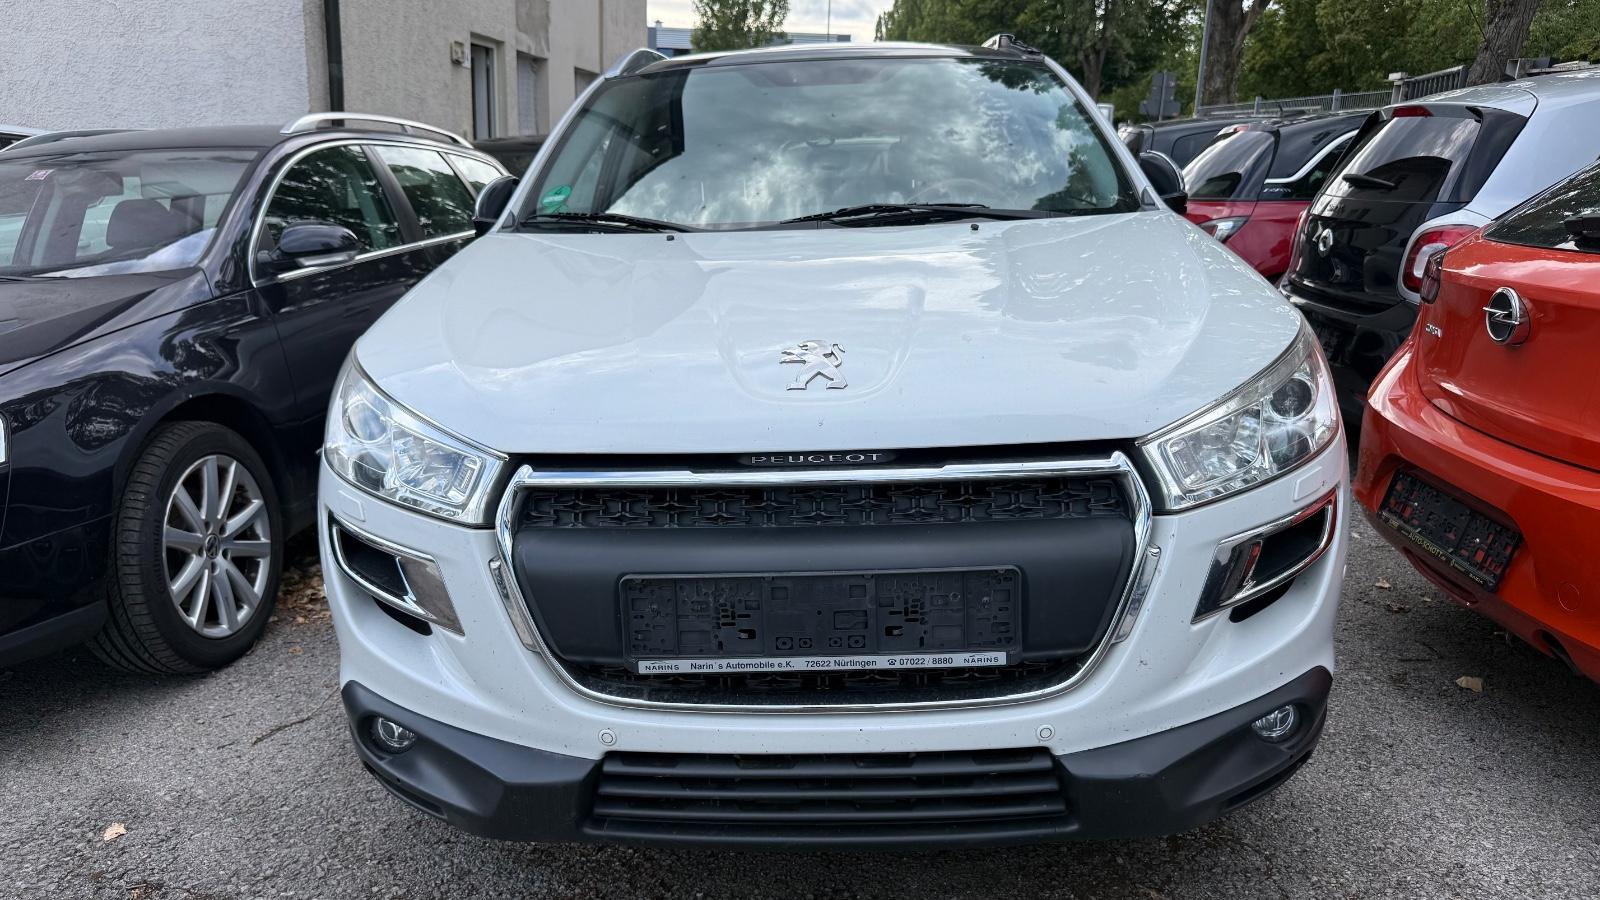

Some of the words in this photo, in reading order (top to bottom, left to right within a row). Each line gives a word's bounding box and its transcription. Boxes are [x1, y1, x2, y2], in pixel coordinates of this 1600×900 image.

[751, 453, 882, 464] PEUGEOT
[726, 660, 775, 670] Automobile
[777, 660, 795, 669] e.K.
[805, 660, 831, 668] 72622
[833, 659, 877, 669] Nürtingen
[963, 656, 999, 664] NARINS
